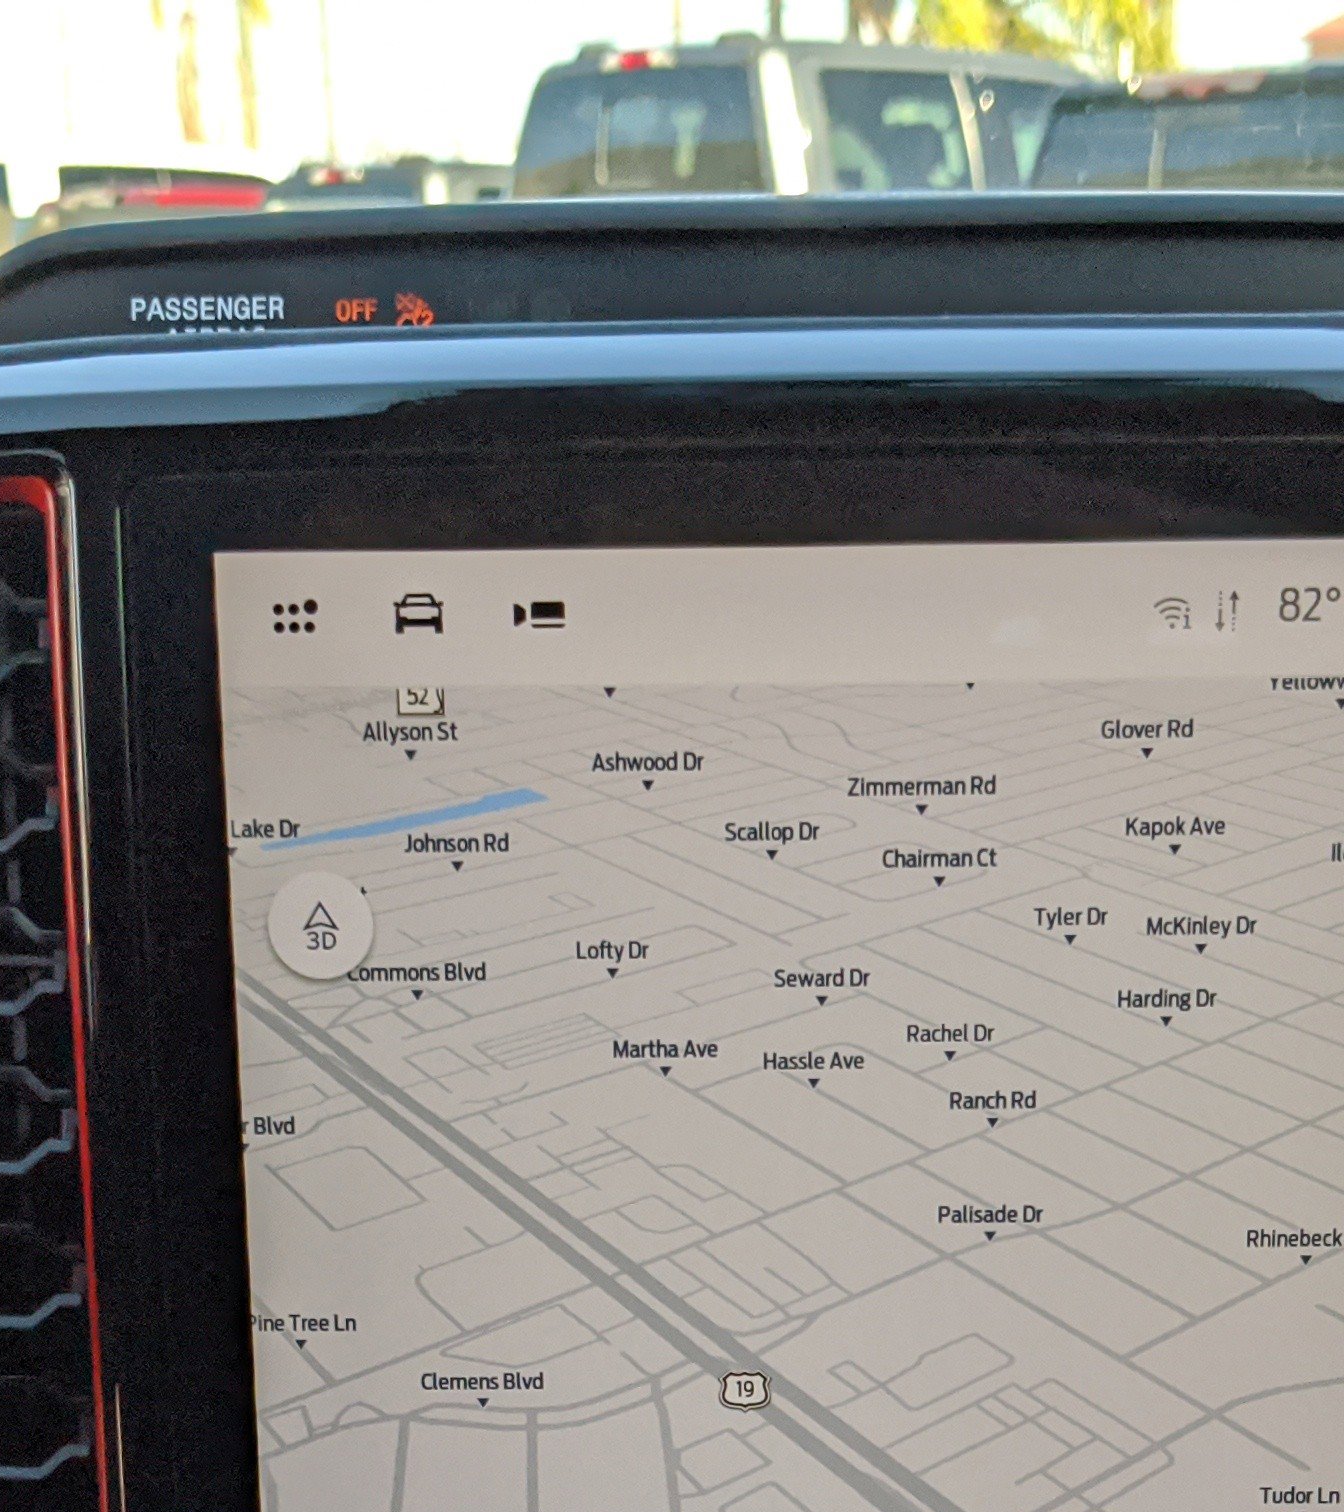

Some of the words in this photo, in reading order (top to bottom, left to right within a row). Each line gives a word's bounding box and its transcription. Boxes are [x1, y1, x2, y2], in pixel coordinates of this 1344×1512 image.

[130, 297, 284, 322] PASSENGER
[336, 299, 377, 323] OFF
[1278, 586, 1341, 622] 82°
[407, 688, 428, 706] 52
[363, 721, 434, 744] Allyson
[437, 721, 458, 741] St
[1100, 719, 1161, 739] Glover
[1166, 719, 1193, 739] Rd
[592, 752, 678, 772] Ashwood
[683, 752, 705, 771] Dr
[847, 776, 965, 796] Zimmerman
[970, 776, 996, 796] Rd
[231, 818, 275, 838] Lake
[280, 819, 300, 838] Dr
[724, 822, 794, 844] Scallop
[798, 822, 820, 842] Dr
[1125, 817, 1184, 839] Kapok
[1189, 817, 1225, 837] Ave
[404, 833, 478, 854] Johnson
[484, 833, 509, 854] Rd
[882, 849, 973, 868] Chairman
[977, 849, 997, 868] Ct
[1035, 907, 1081, 929] Tyler
[1087, 907, 1108, 927] Dr
[1146, 915, 1231, 938] McKinley
[1236, 915, 1256, 936] Dr
[306, 932, 337, 950] 3D
[576, 940, 622, 963] Lofty
[627, 940, 649, 960] Dr
[444, 962, 486, 981] Blvd
[774, 969, 844, 988] Seward
[849, 969, 870, 988] Dr
[1117, 989, 1191, 1012] Harding
[1196, 989, 1216, 1010] Dr
[906, 1024, 968, 1043] Rachel
[972, 1024, 994, 1043] Dr
[613, 1040, 679, 1059] Martha
[682, 1040, 718, 1058] Ave
[763, 1051, 824, 1071] Hassle
[828, 1051, 864, 1071] Ave
[949, 1091, 1005, 1110] Ranch
[1011, 1091, 1036, 1110] Rd
[254, 1116, 295, 1134] Blvd
[938, 1205, 1018, 1224] Palisade
[1022, 1205, 1044, 1224] Dr
[1246, 1229, 1343, 1248] Rhinebeck
[288, 1314, 329, 1331] Tree
[333, 1314, 356, 1331] Ln
[421, 1372, 499, 1391] Clemens
[502, 1372, 543, 1390] Blvd
[736, 1381, 755, 1397] 19
[1260, 1487, 1313, 1505] Tudor
[1318, 1487, 1340, 1505] Ln
